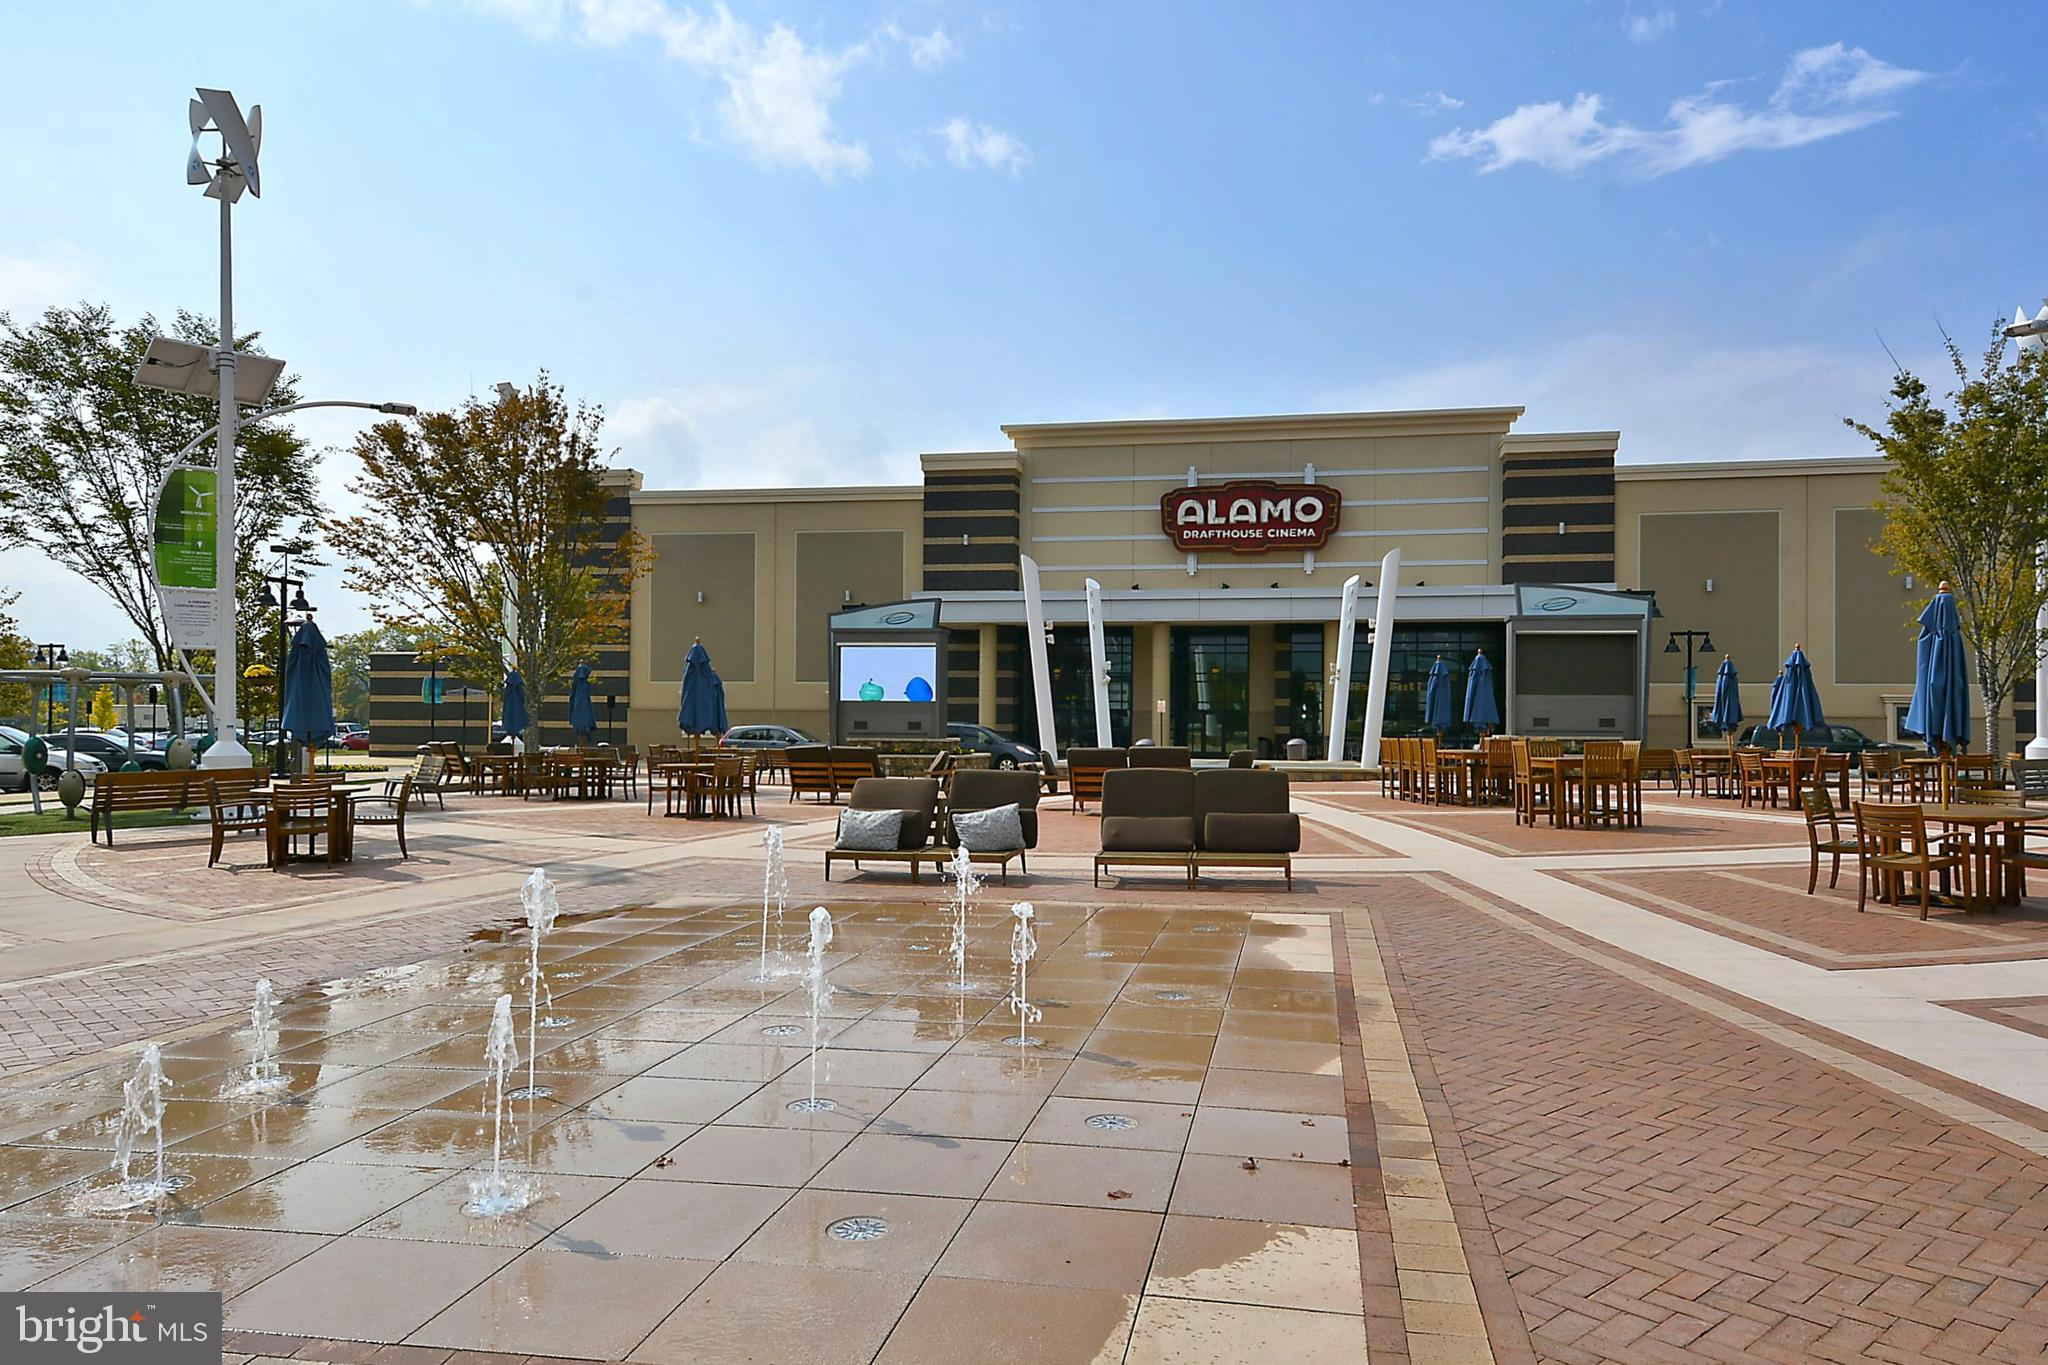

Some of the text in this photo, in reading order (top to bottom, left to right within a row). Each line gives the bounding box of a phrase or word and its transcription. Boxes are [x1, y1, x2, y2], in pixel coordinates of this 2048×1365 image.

[1177, 496, 1324, 526] ALAMO
[1183, 527, 1317, 540] DRAFTHOUSE CINEMA
